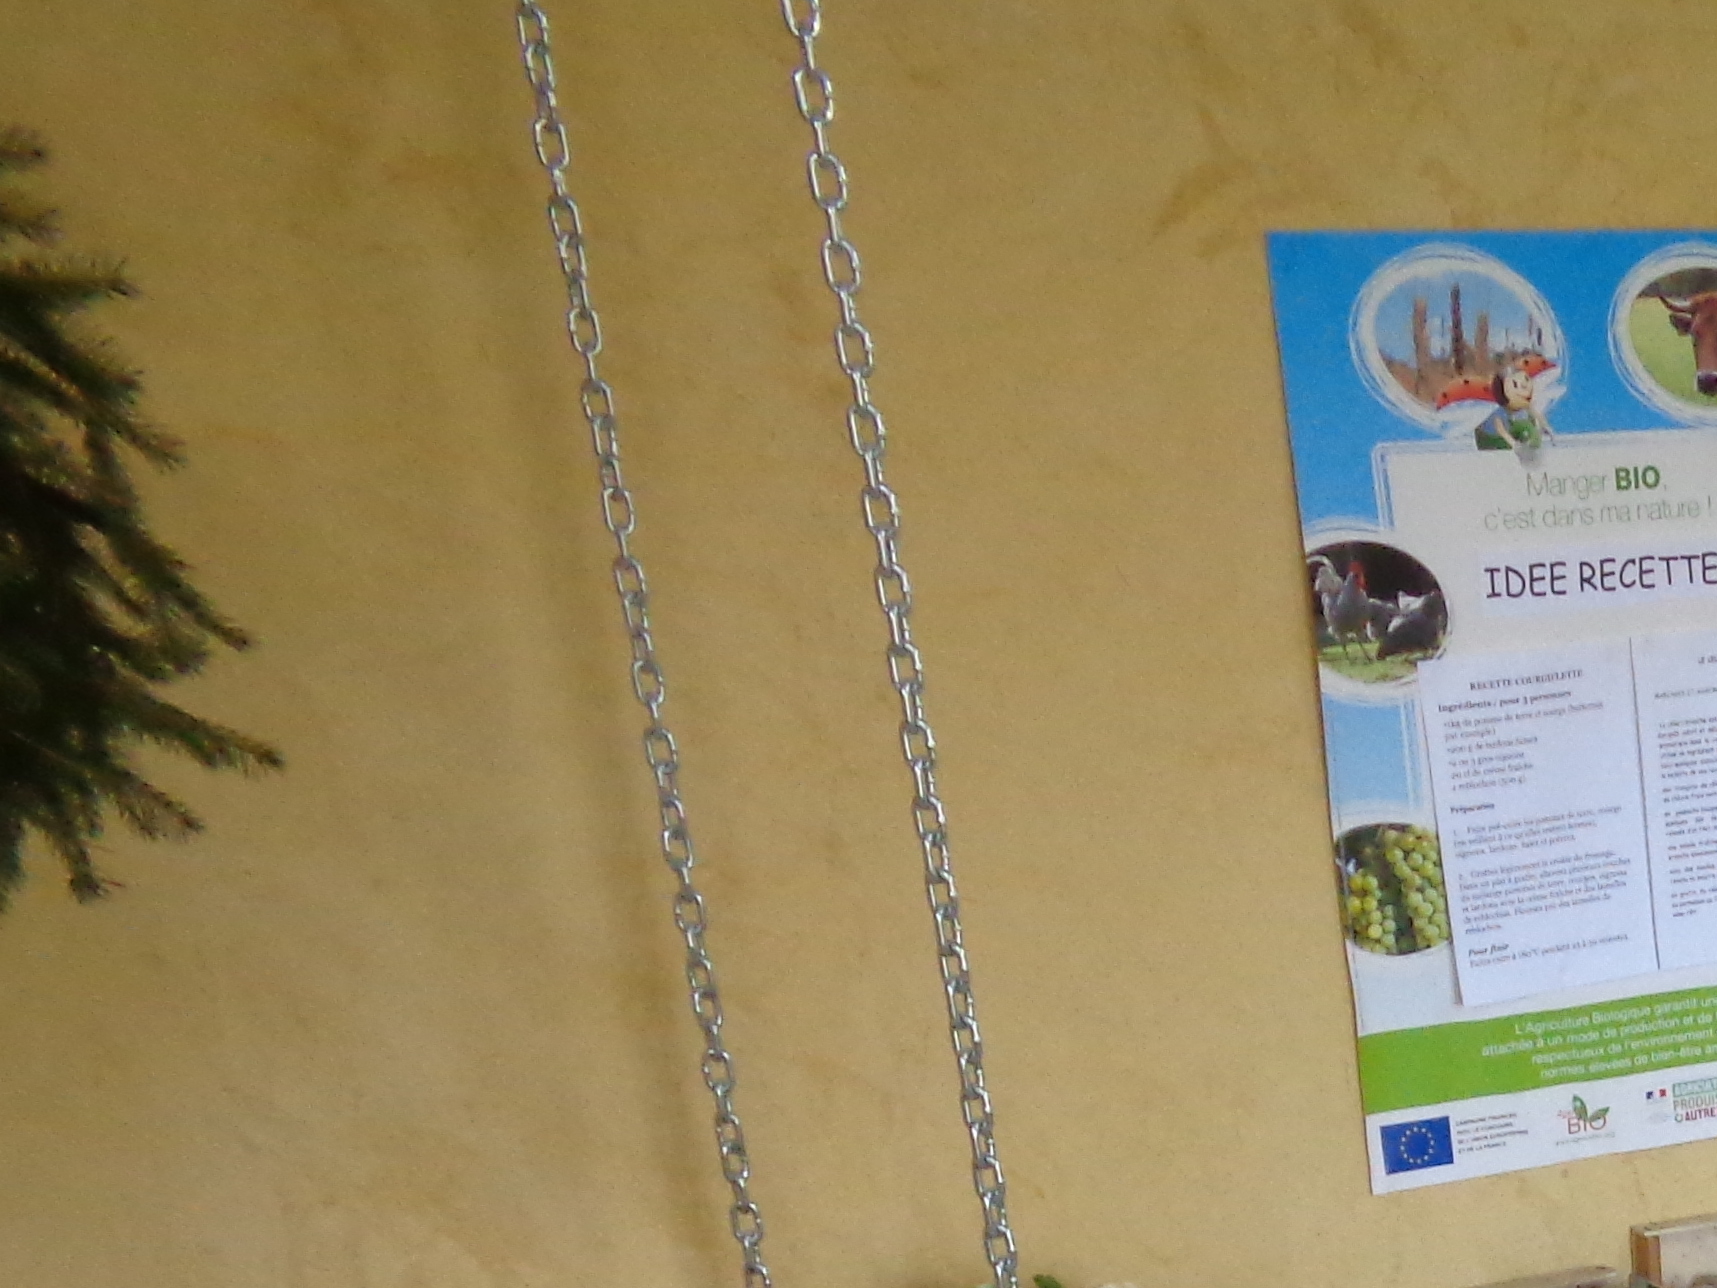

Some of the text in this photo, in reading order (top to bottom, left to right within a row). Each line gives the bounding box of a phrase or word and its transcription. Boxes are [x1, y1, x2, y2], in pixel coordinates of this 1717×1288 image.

[1526, 472, 1607, 499] Manger
[1484, 496, 1712, 531] c'est dans ma nature !
[1484, 561, 1567, 599] IDEE
[1515, 1015, 1589, 1036] L'Agriculture
[1592, 1006, 1651, 1028] Biologique
[1547, 1034, 1562, 1045] un
[1567, 1029, 1600, 1043] mode
[1602, 1026, 1617, 1039] de
[1620, 1016, 1680, 1037] production
[1682, 1014, 1694, 1025] et
[1697, 1010, 1713, 1025] de
[1531, 1046, 1605, 1066] respectueux
[1607, 1041, 1622, 1055] de
[1624, 1028, 1714, 1050] l'environnement
[1540, 1063, 1585, 1079] normes
[1634, 1053, 1649, 1066] de
[1567, 1113, 1607, 1134] BIO
